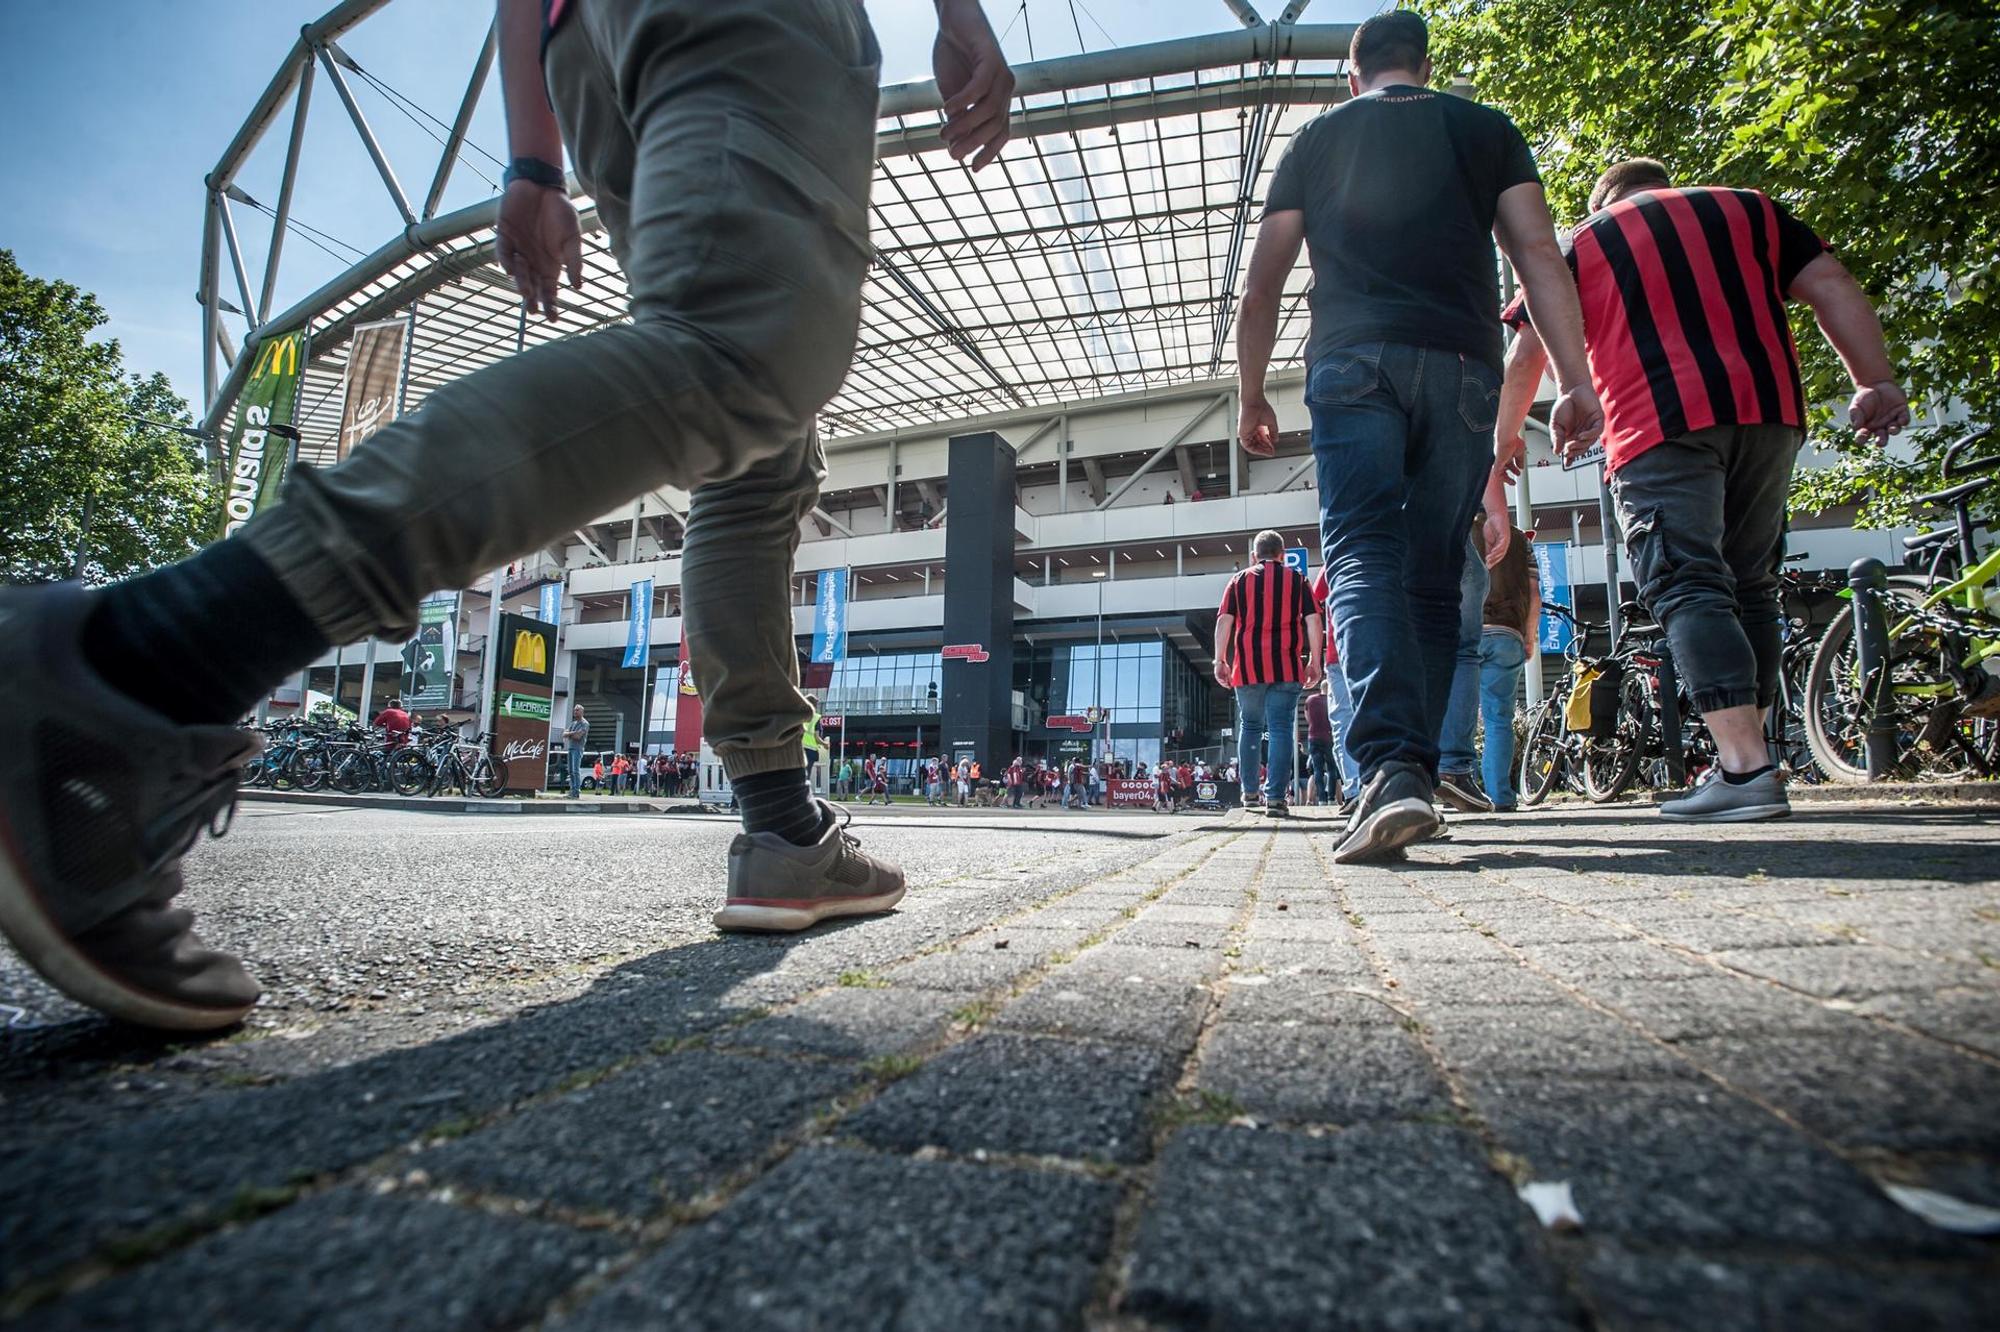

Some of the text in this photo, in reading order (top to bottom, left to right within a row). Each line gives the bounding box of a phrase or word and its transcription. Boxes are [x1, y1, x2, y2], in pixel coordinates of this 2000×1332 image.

[1376, 94, 1435, 103] PREDATOR
[1284, 553, 1300, 567] P
[503, 739, 544, 760] McCafé
